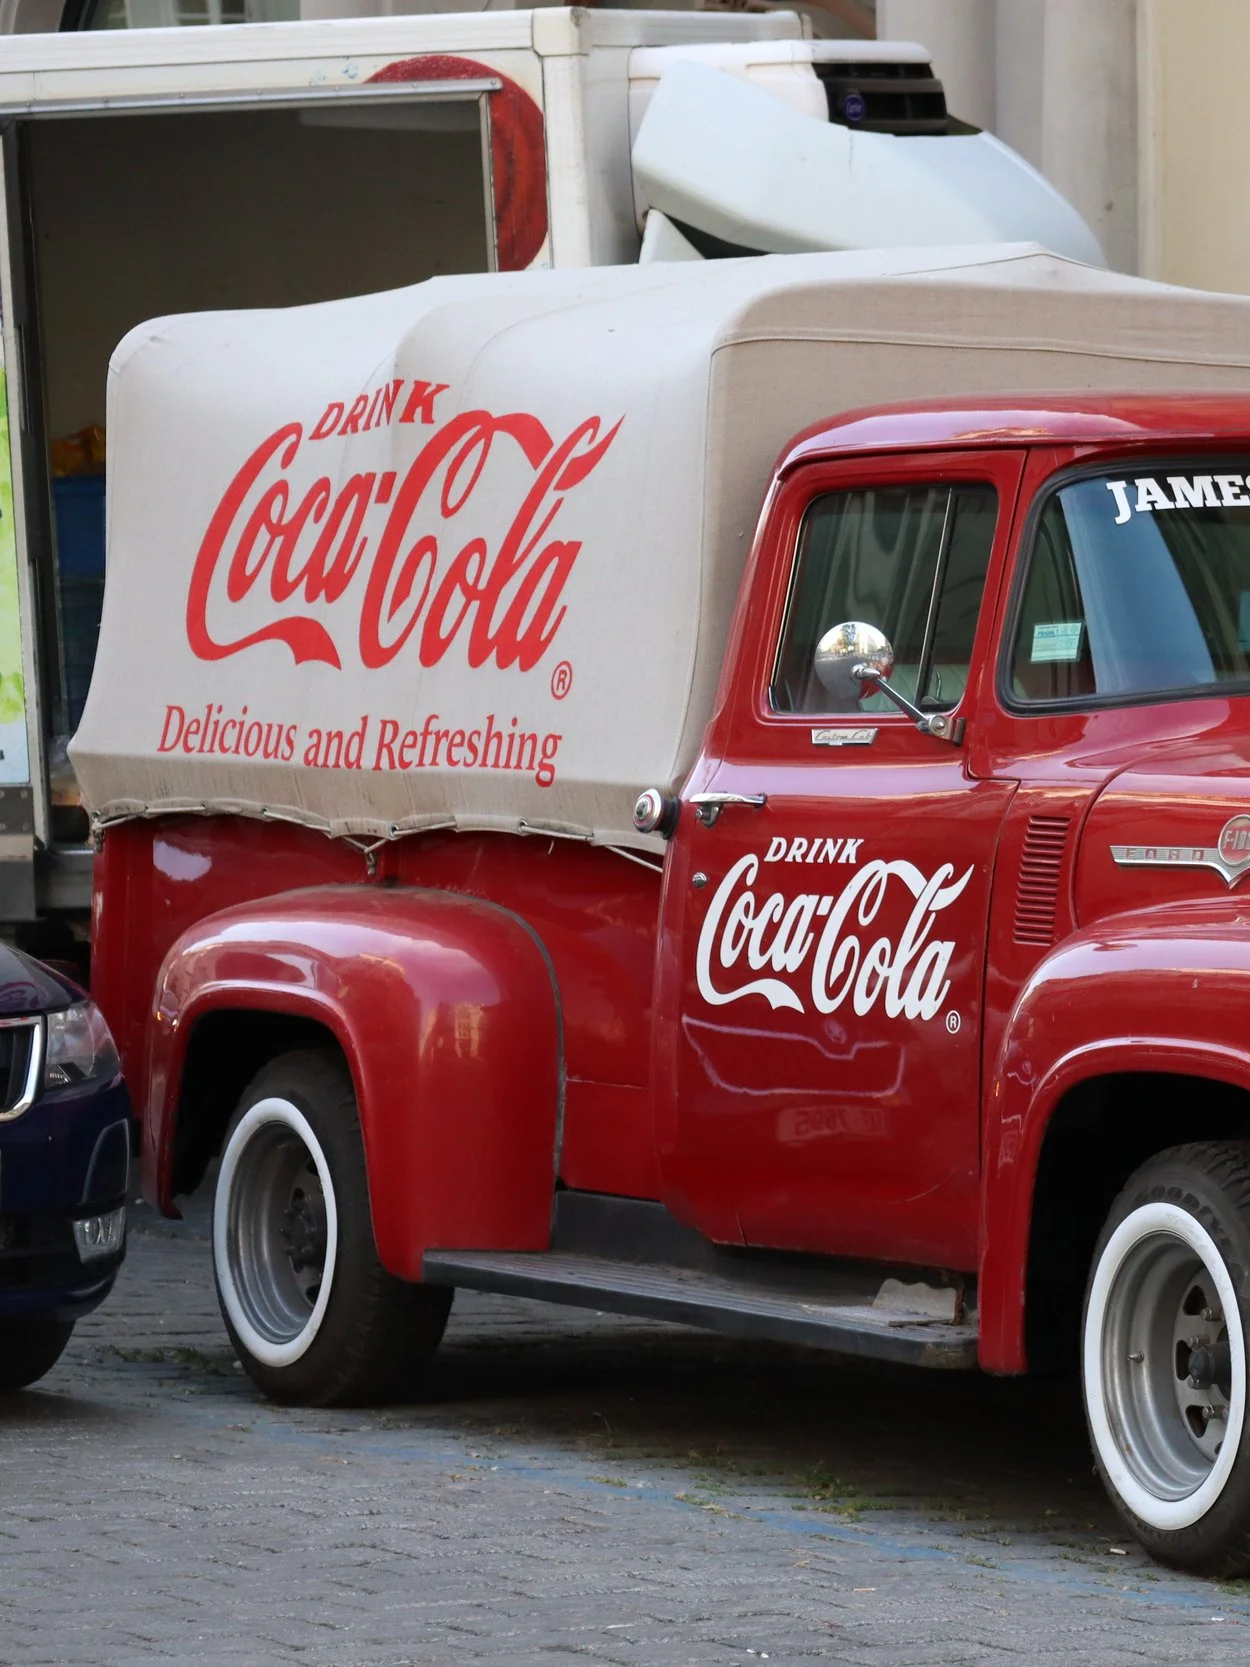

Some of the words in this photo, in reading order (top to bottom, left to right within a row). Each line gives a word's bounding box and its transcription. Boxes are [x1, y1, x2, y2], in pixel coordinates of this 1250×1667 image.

[309, 379, 449, 441] DRINK
[158, 704, 299, 763] Delicious
[303, 715, 370, 770] and
[373, 714, 563, 788] Refreshing
[764, 836, 865, 864] DRINK
[1125, 847, 1205, 861] FORD
